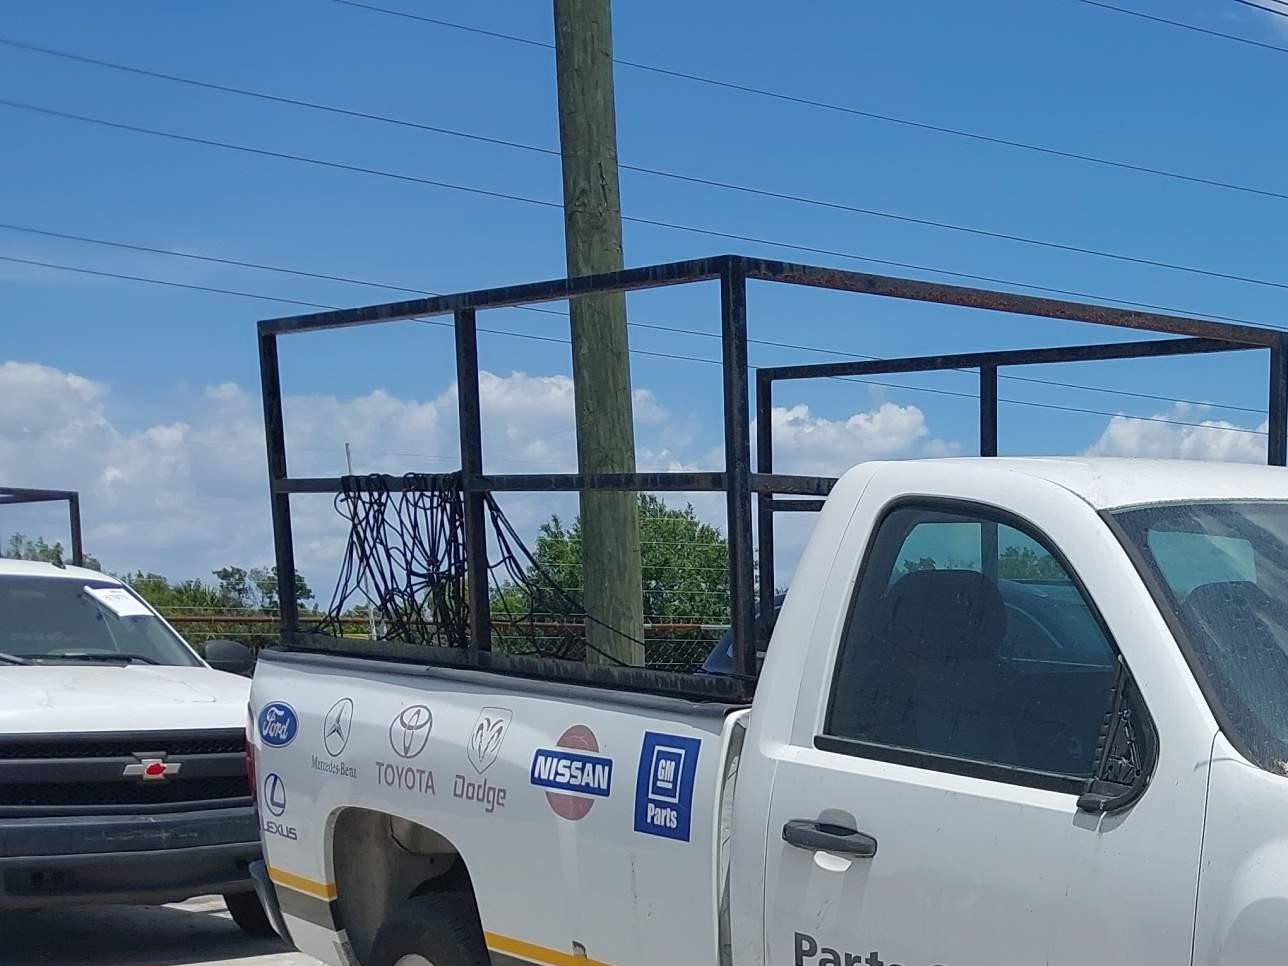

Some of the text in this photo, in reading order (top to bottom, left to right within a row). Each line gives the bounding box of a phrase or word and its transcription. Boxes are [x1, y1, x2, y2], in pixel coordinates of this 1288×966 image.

[262, 706, 291, 740] Ford
[311, 755, 357, 778] Mercedes-Benz
[376, 762, 435, 795] TOYOTA
[534, 755, 609, 789] NISSAN
[657, 759, 676, 781] GM
[453, 775, 506, 813] Dodge
[263, 821, 297, 840] LEXUS
[647, 803, 677, 829] Parts
